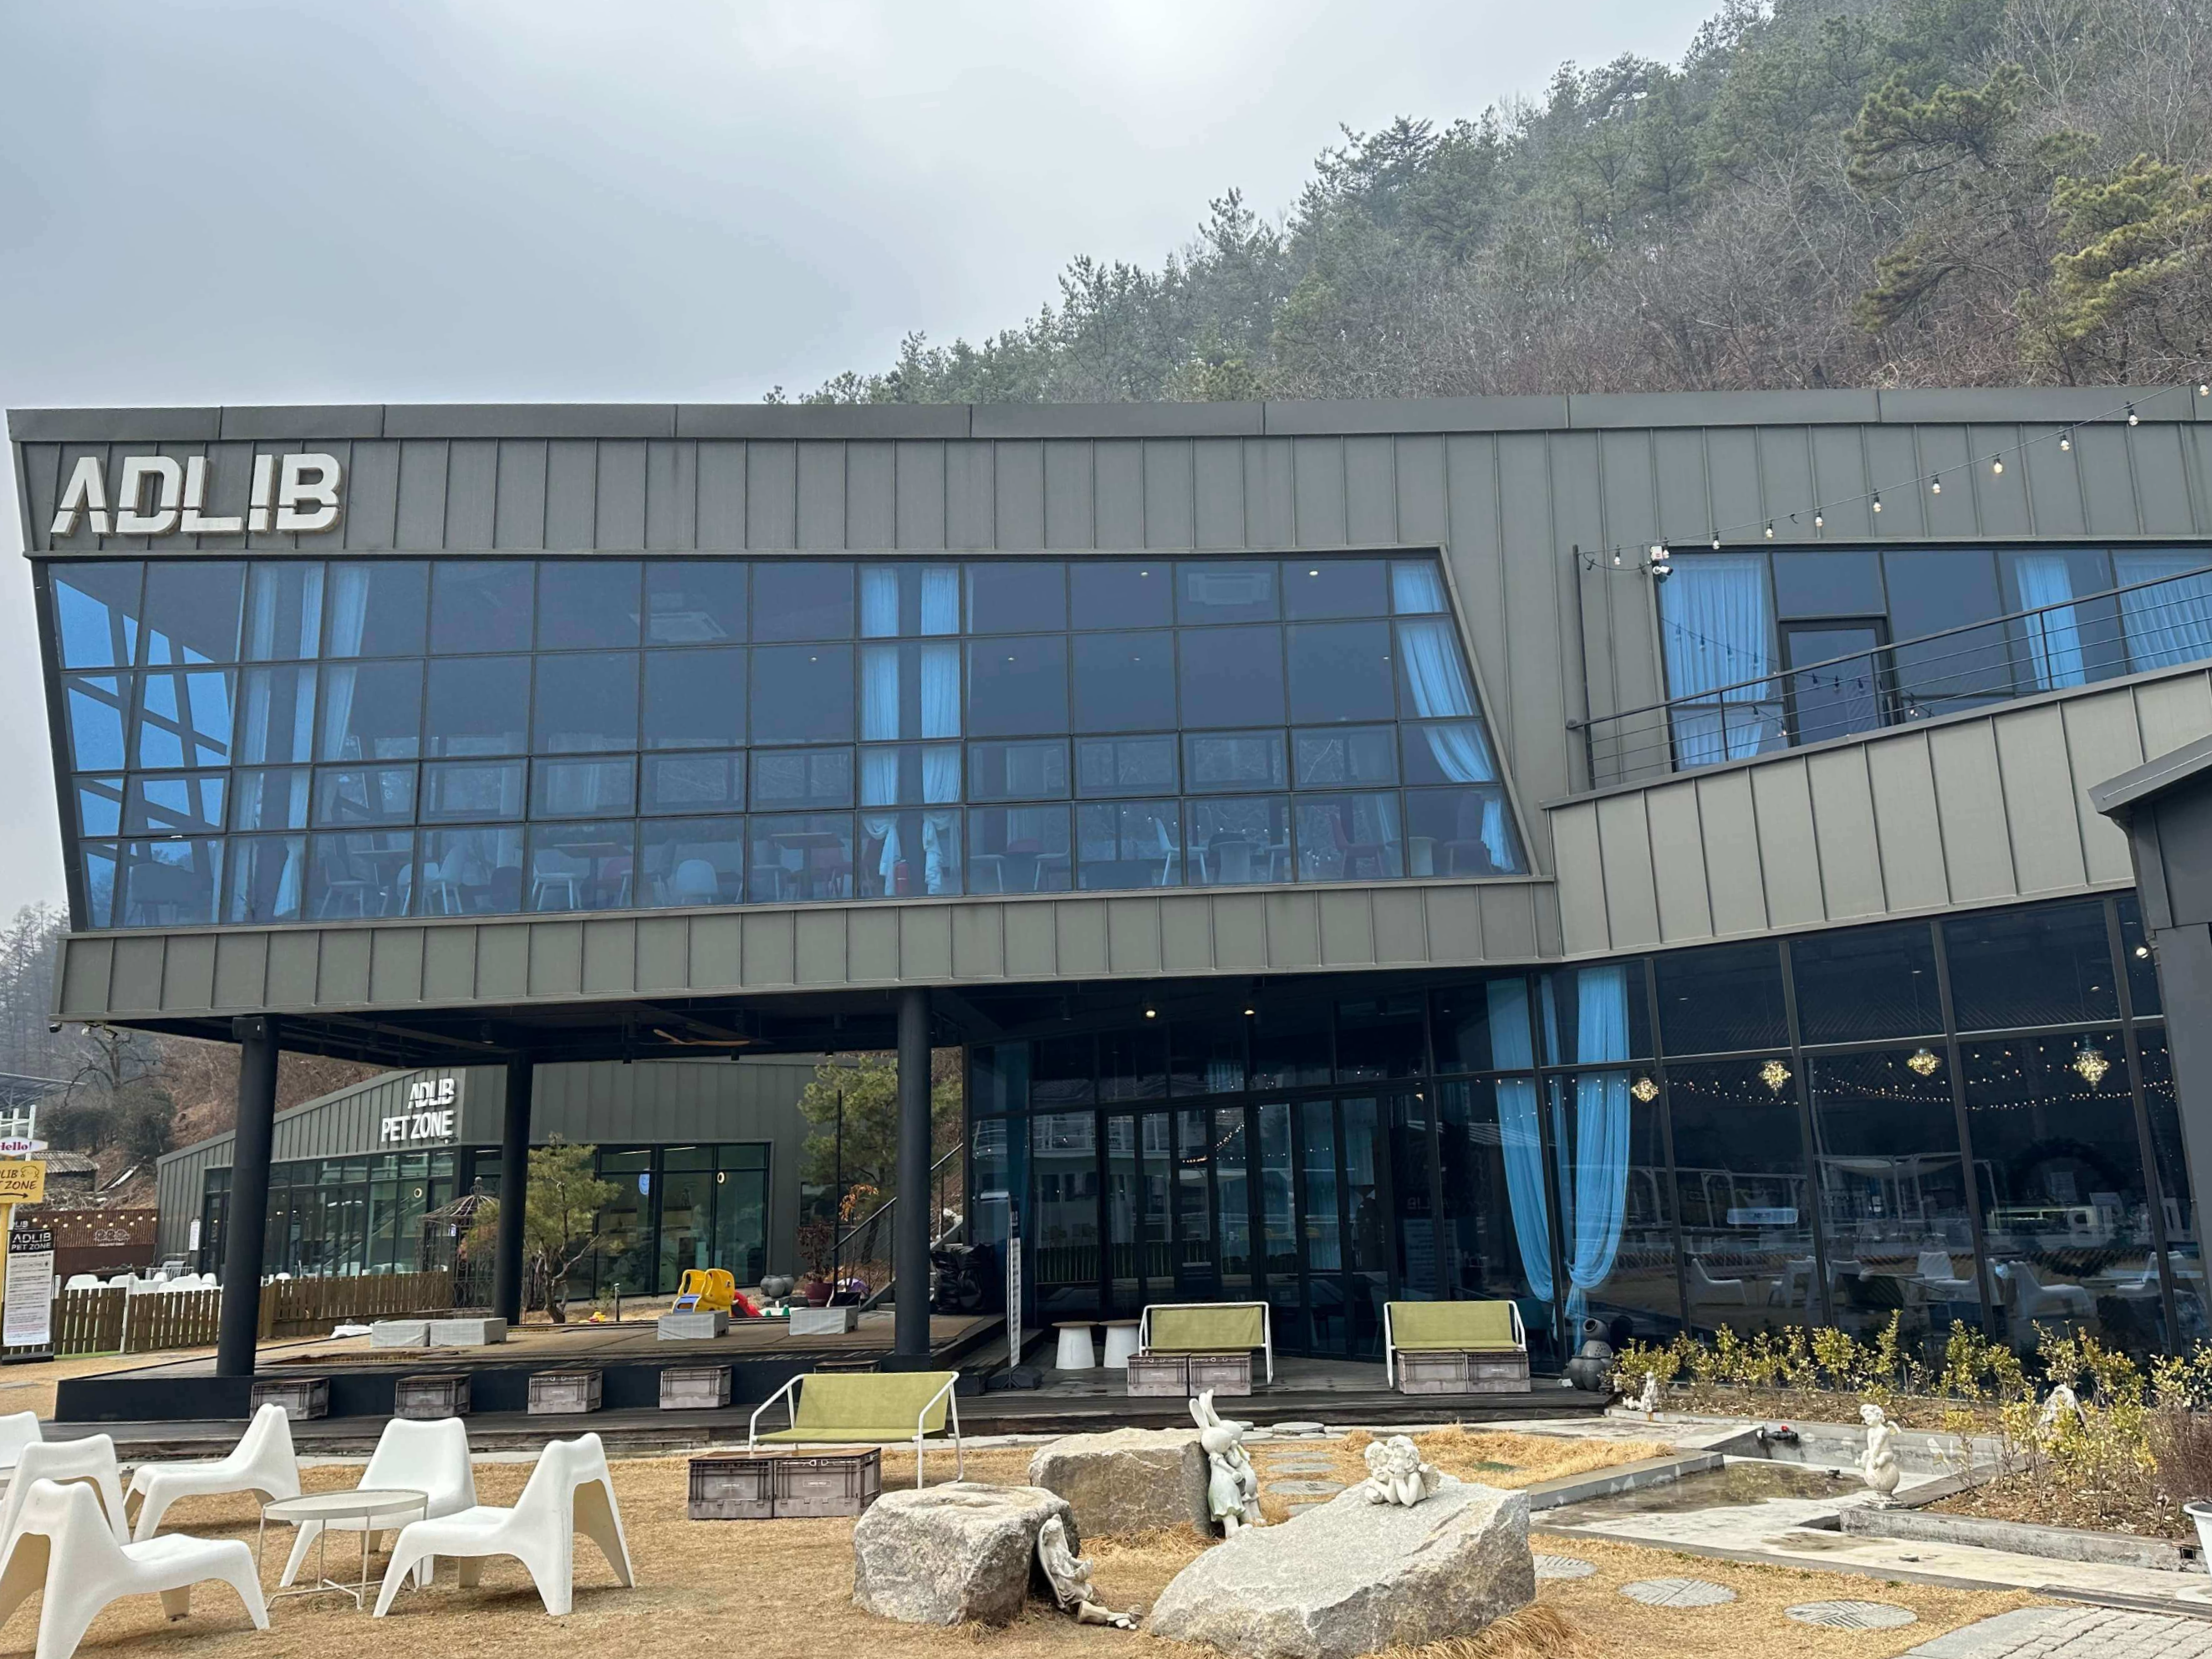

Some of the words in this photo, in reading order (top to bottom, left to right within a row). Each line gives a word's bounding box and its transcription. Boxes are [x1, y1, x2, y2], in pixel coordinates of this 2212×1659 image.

[50, 452, 342, 535] ADLIB
[407, 1078, 455, 1109] ADLIB
[381, 1115, 410, 1142] PET
[410, 1110, 454, 1139] ZONE
[0, 1169, 18, 1179] LIB
[4, 1180, 38, 1190] ZONE
[13, 1232, 51, 1243] ADLIB
